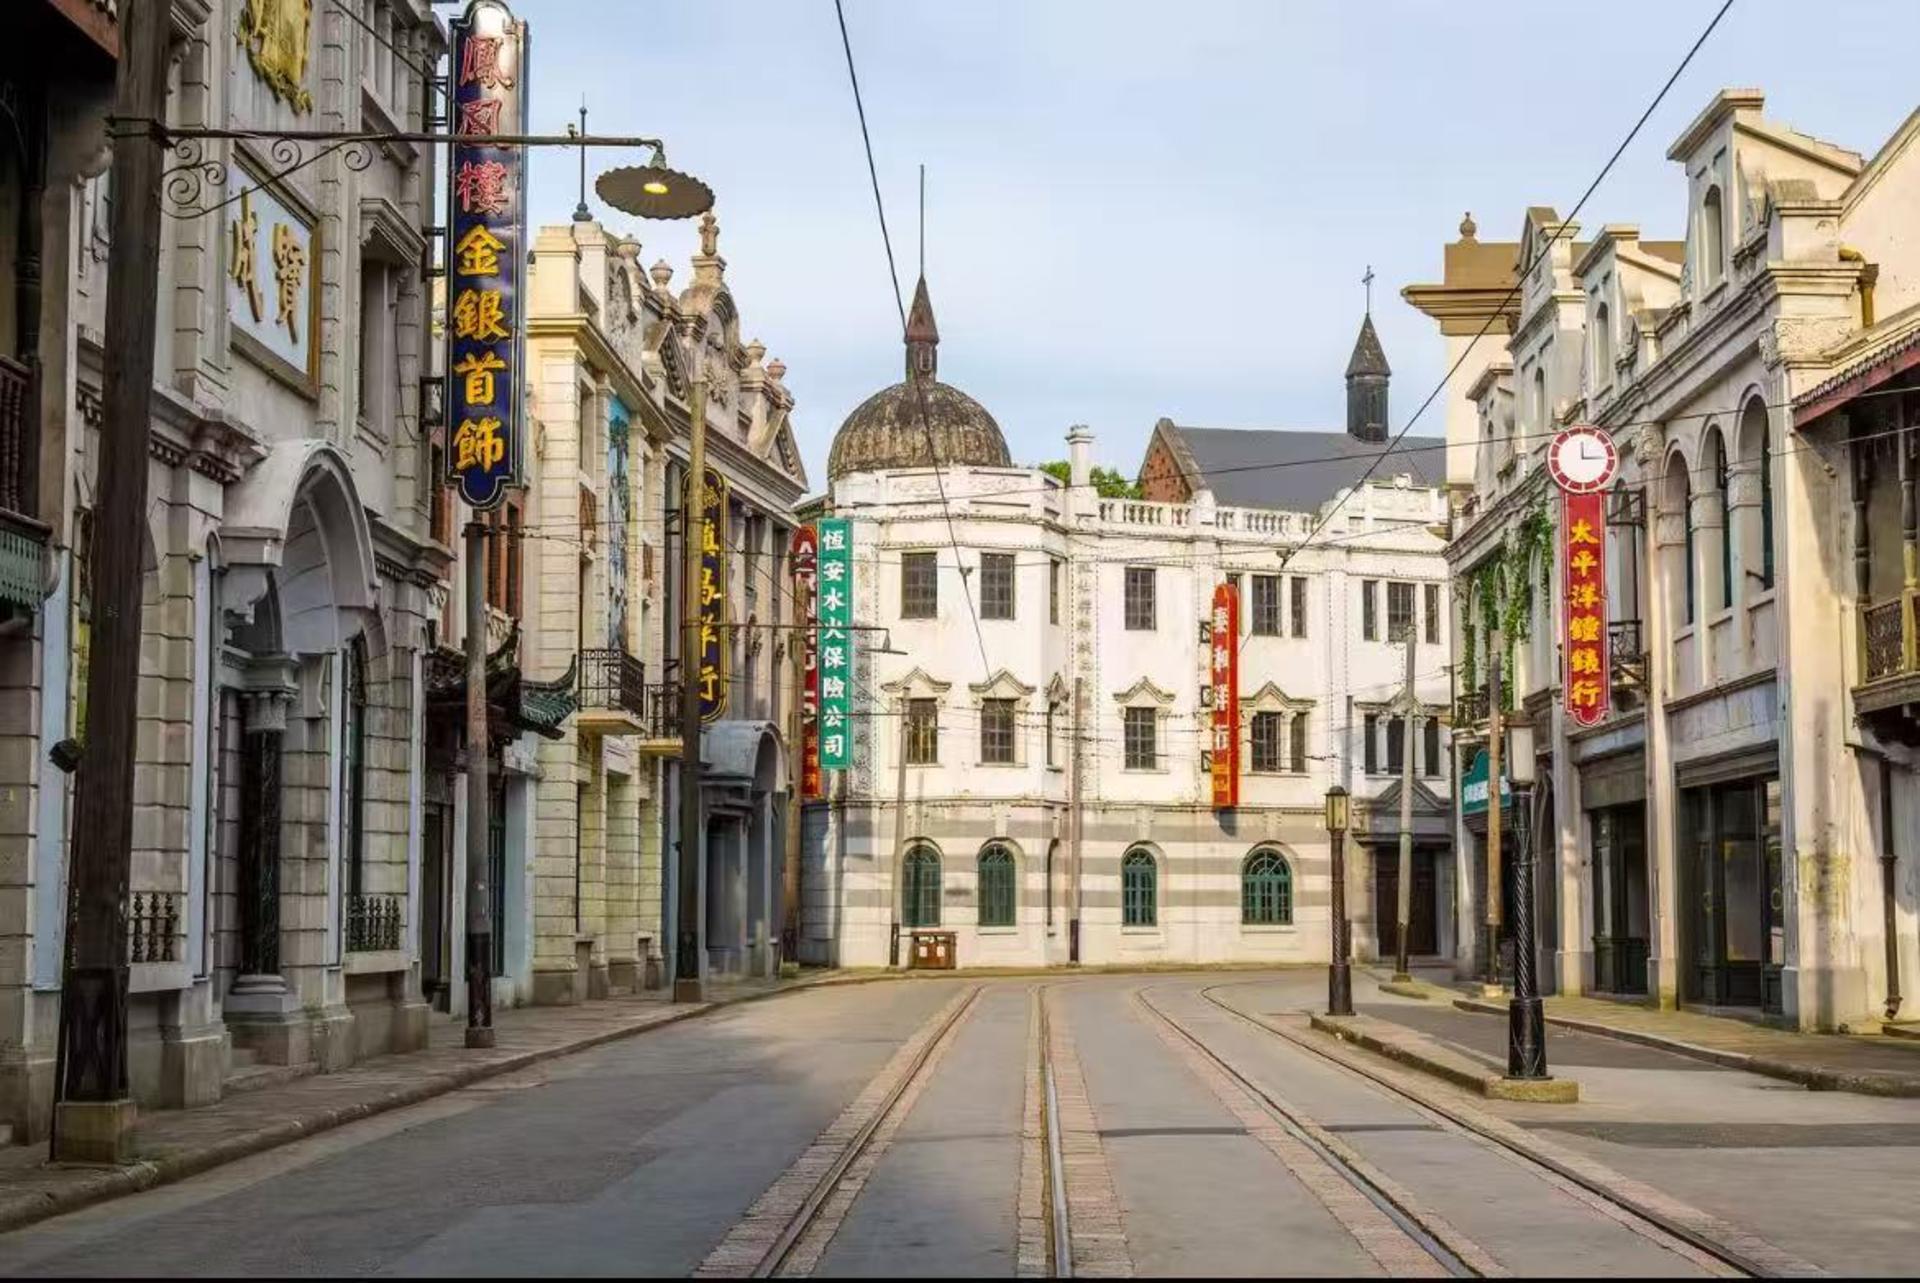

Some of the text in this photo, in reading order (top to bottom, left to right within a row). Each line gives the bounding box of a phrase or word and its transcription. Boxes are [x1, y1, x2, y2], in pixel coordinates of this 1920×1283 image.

[821, 529, 847, 758] 恆安水火保險公司
